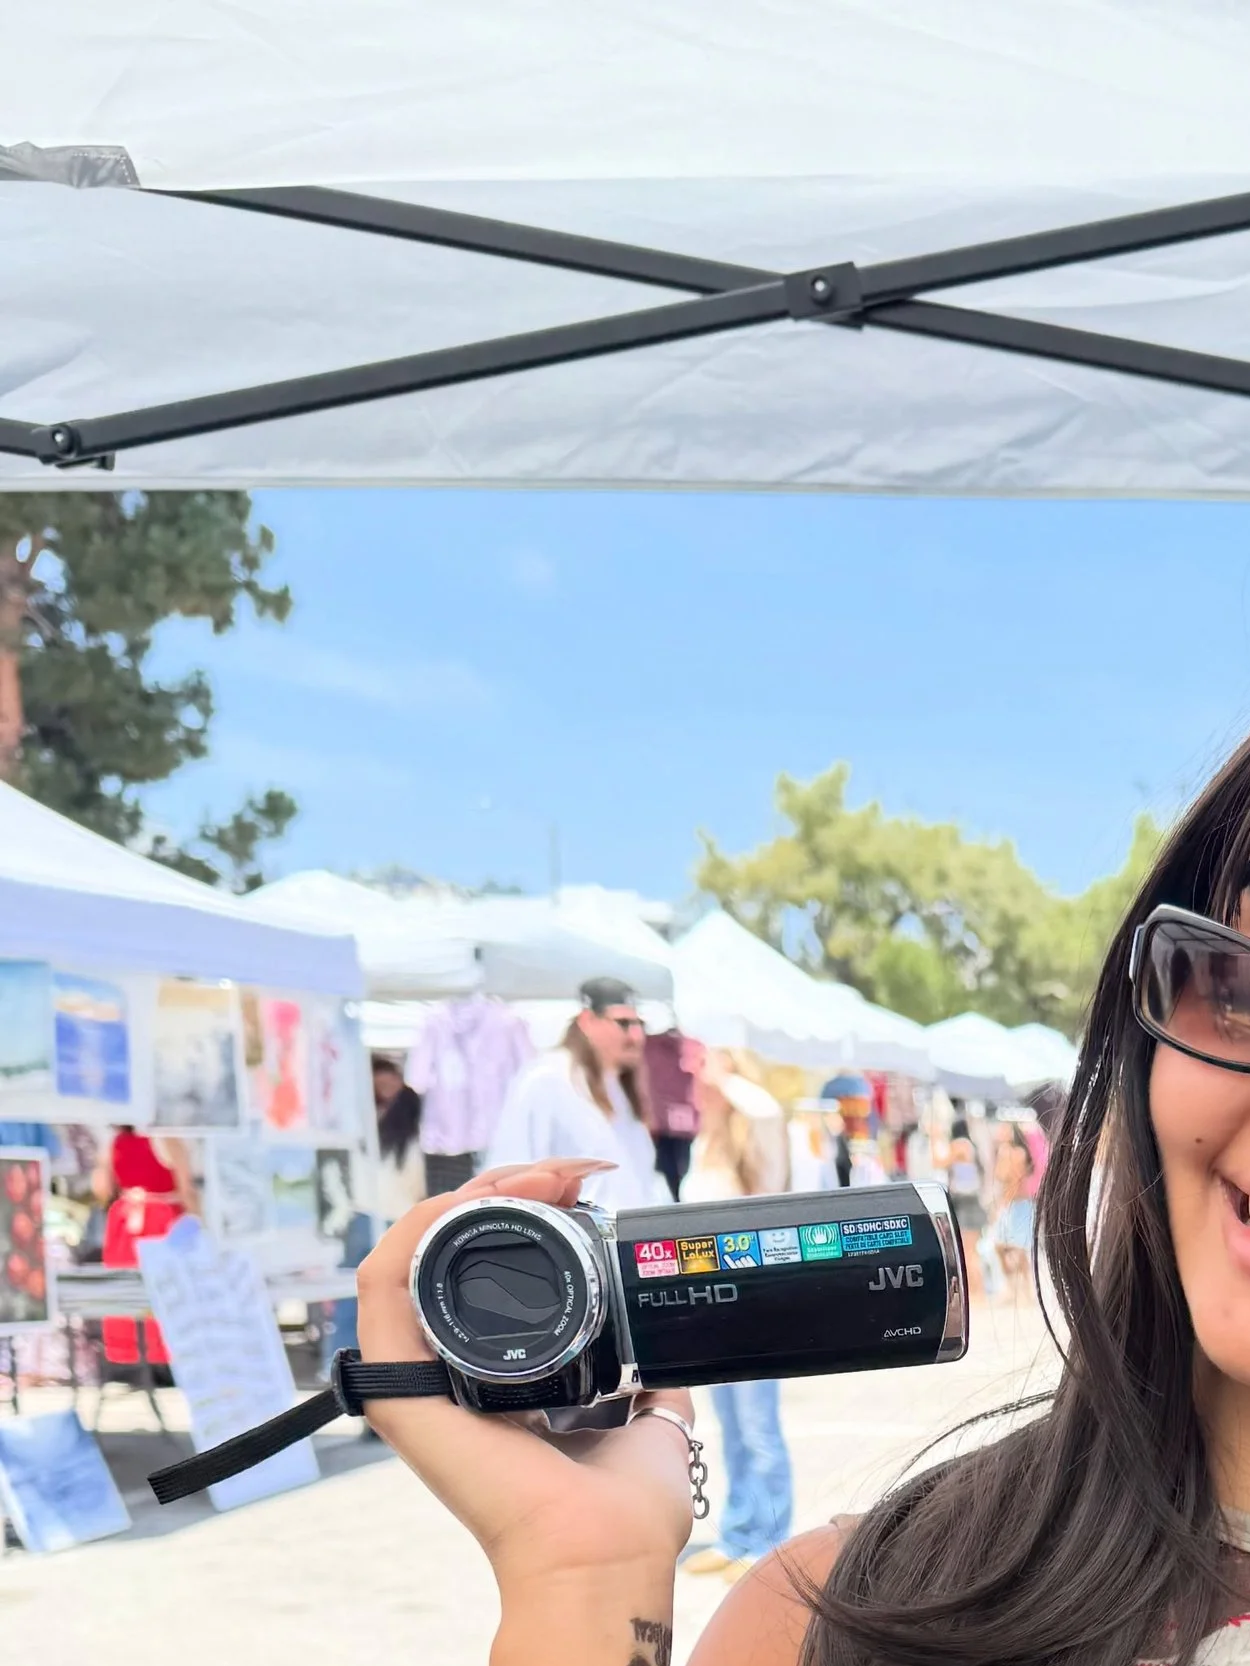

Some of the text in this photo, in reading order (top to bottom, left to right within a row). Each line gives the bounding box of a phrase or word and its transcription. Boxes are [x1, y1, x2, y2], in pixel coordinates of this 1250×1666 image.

[479, 1222, 510, 1232] MINOLTA
[511, 1225, 523, 1233] HD
[843, 1219, 908, 1235] SD/SDHC/SDXC
[639, 1242, 674, 1261] 40x
[680, 1240, 713, 1251] Super
[868, 1264, 924, 1291] JVC
[565, 1284, 575, 1318] OPTICAL
[554, 1315, 569, 1337] ZOOM
[883, 1326, 922, 1338] AVCHD
[502, 1348, 527, 1361] JVC
